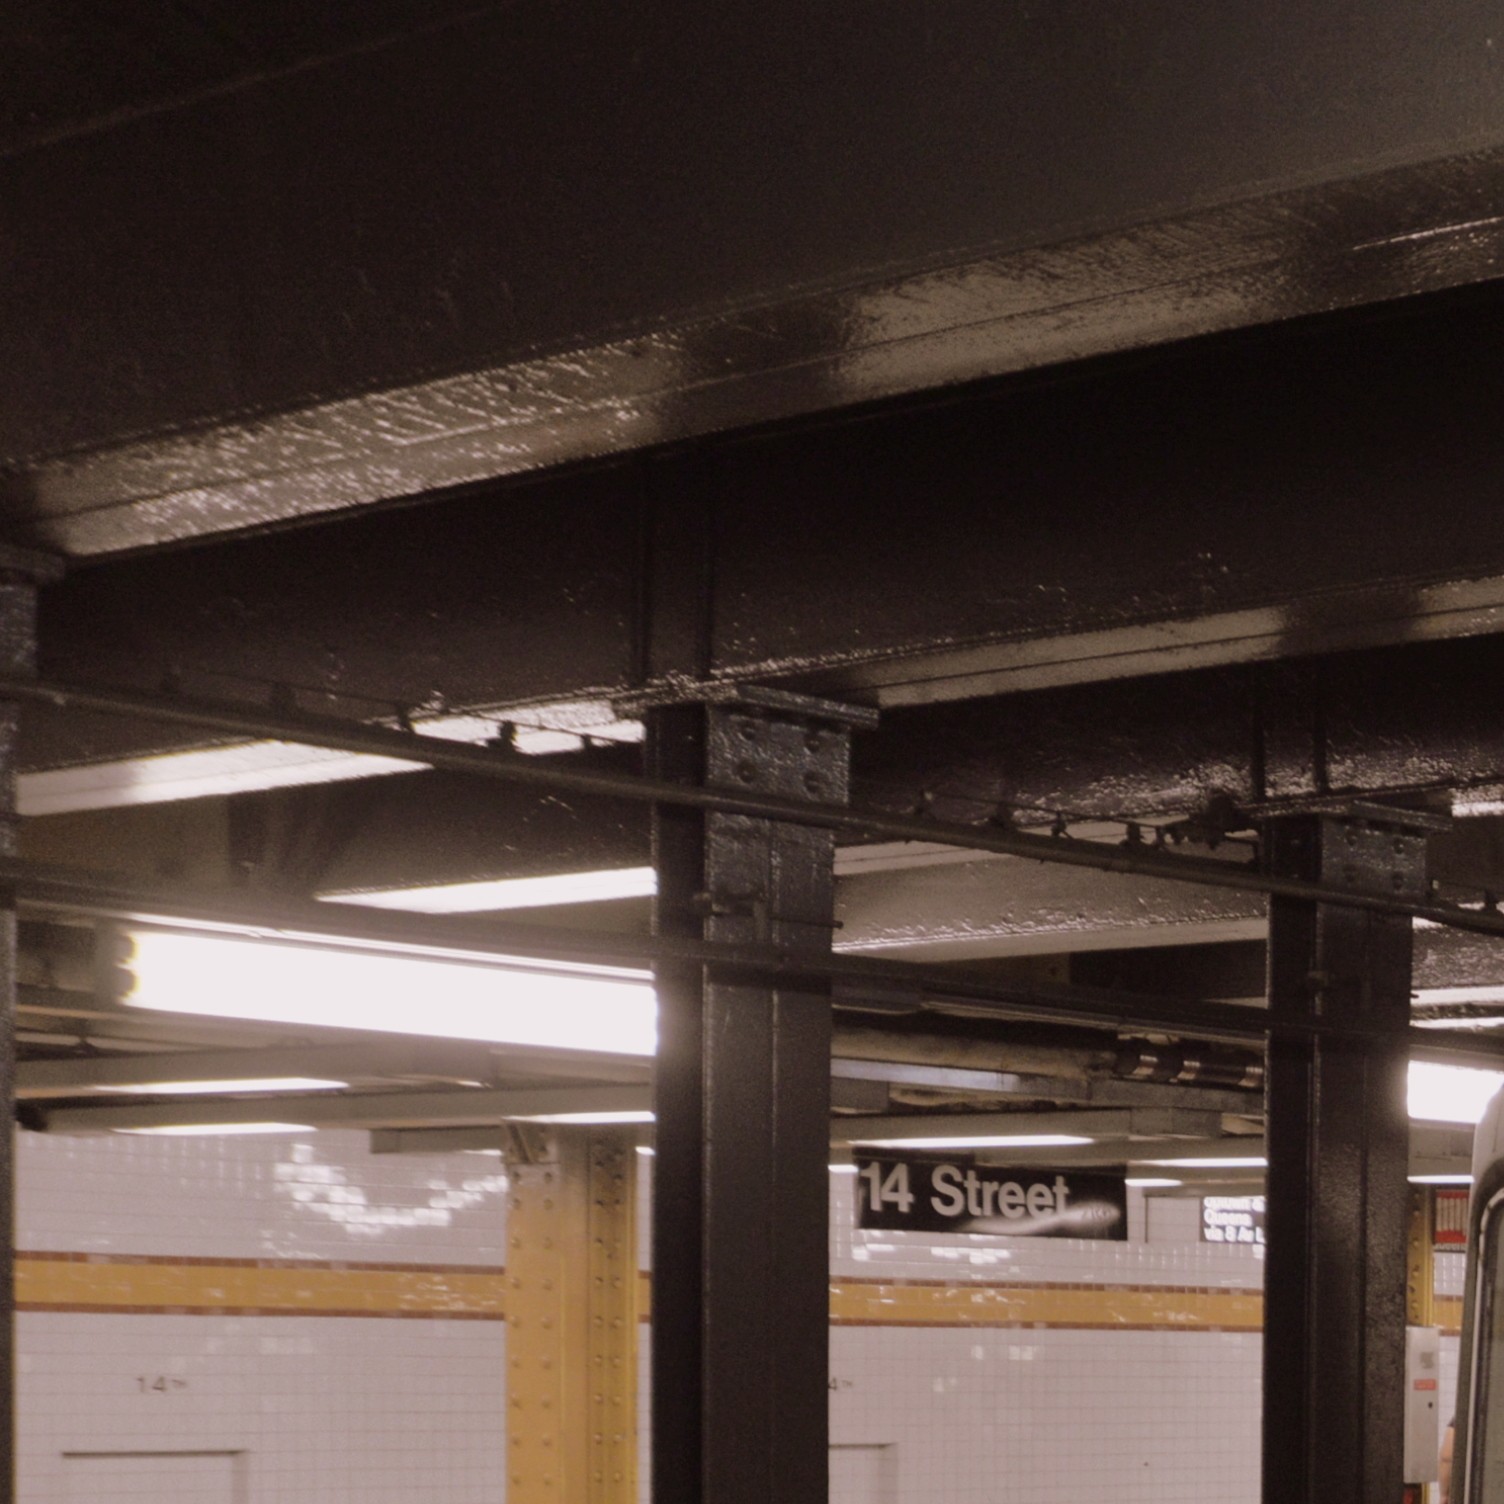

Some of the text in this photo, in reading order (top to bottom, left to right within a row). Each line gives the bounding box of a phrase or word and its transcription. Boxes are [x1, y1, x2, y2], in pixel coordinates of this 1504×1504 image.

[860, 1161, 1069, 1219] 14 Street
[1204, 1208, 1253, 1227] Queens
